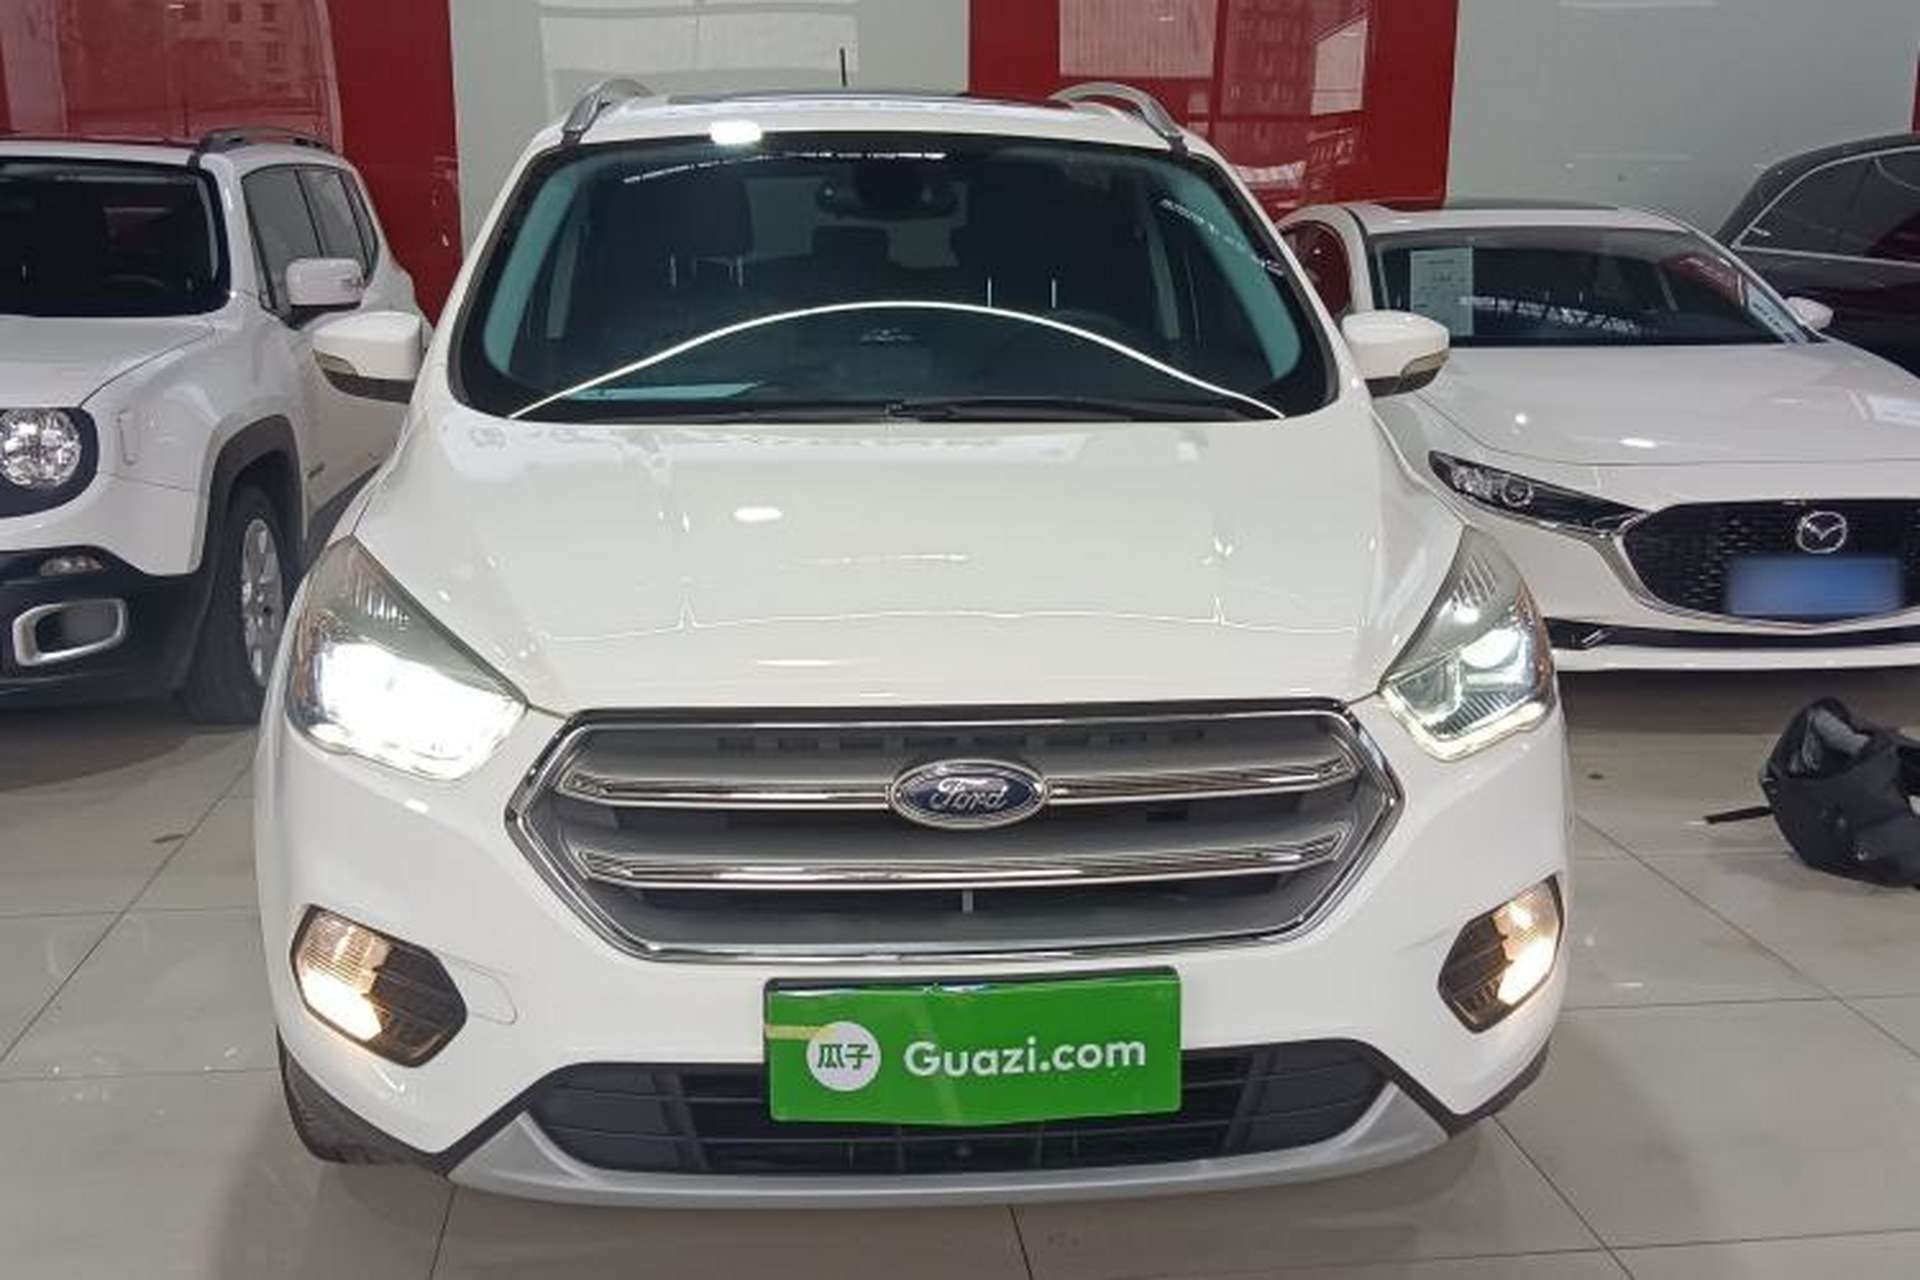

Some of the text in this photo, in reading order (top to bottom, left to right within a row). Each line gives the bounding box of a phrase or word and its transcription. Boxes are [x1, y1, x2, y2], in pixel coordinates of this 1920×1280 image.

[930, 777, 1008, 809] Ford
[818, 1043, 872, 1069] 瓜子
[904, 1036, 1146, 1076] Guazi.com
